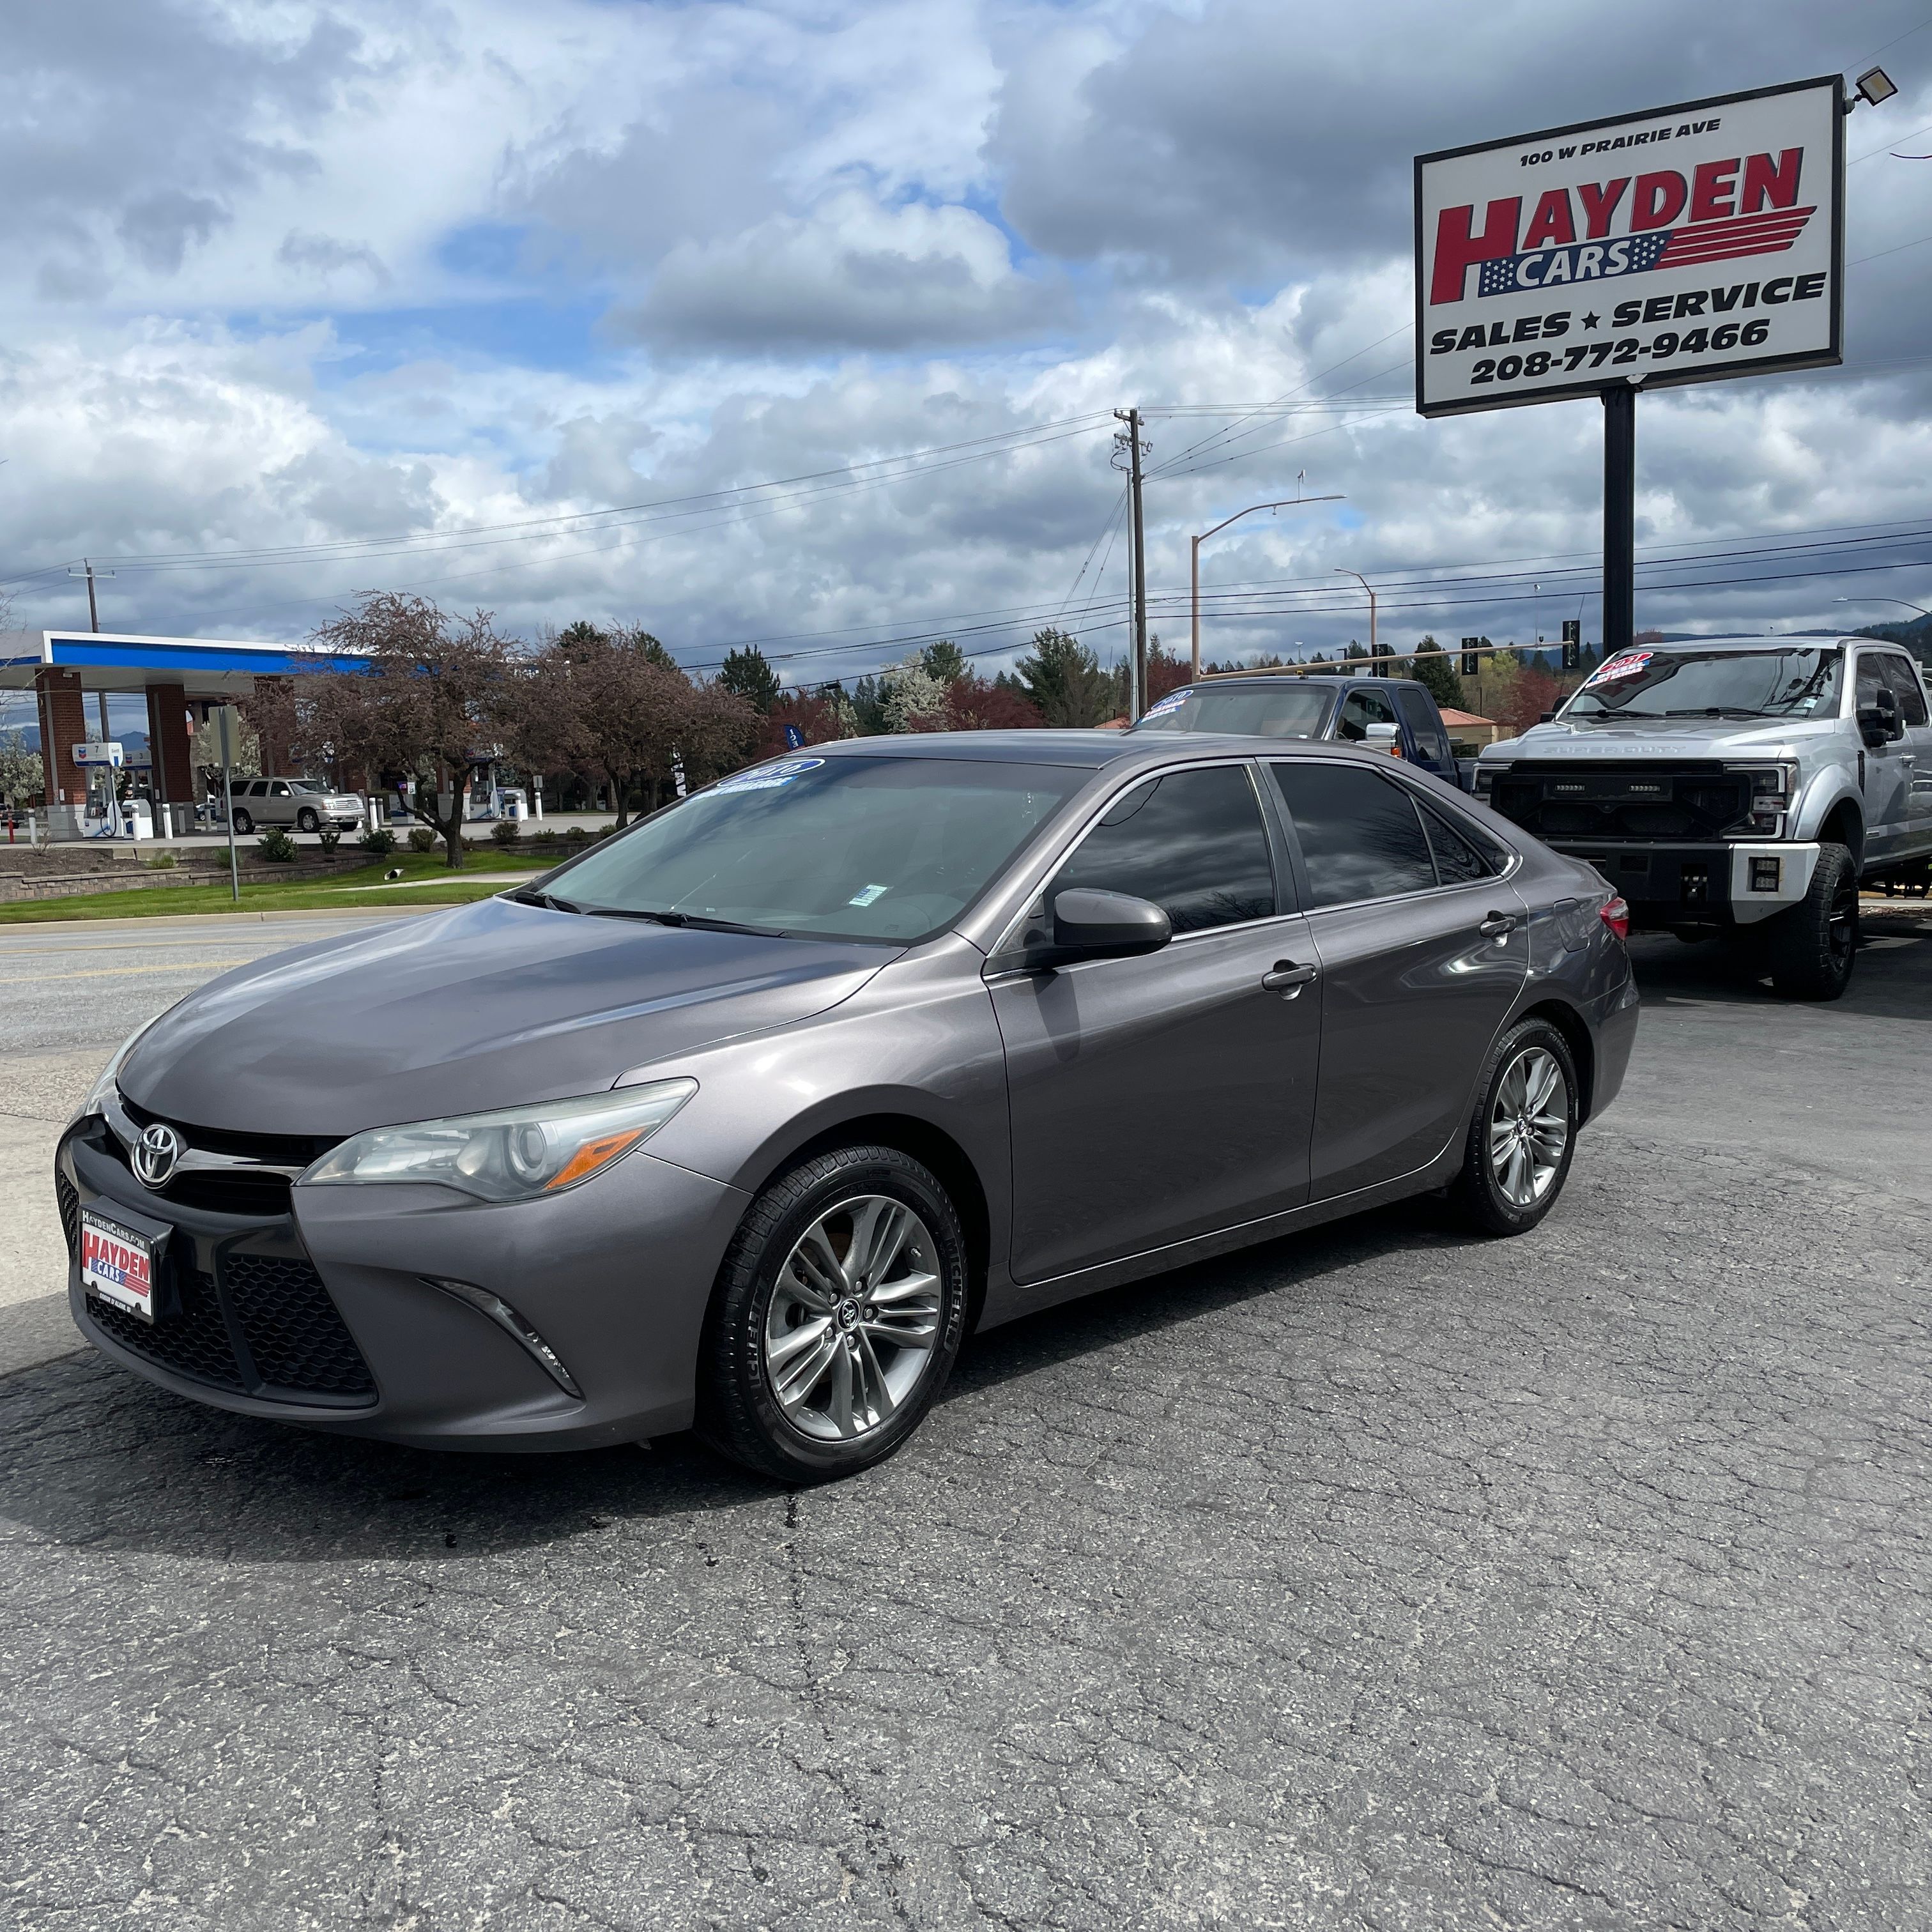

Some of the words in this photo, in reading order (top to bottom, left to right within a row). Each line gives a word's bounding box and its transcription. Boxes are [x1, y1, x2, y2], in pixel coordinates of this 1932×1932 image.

[1520, 150, 1553, 167] 100
[1558, 146, 1578, 160] W
[1580, 128, 1671, 157] PRAIRIE
[1675, 118, 1721, 138] AVE
[1430, 146, 1805, 305] HAYDEN
[1515, 240, 1632, 288] CARS
[1430, 311, 1571, 355] SALES
[1612, 272, 1827, 328] SERVICE
[1471, 319, 1771, 385] 208-772-9466
[1606, 654, 1642, 671] 2021
[83, 1230, 150, 1282] HAYDEN
[97, 1261, 120, 1282] CARS
